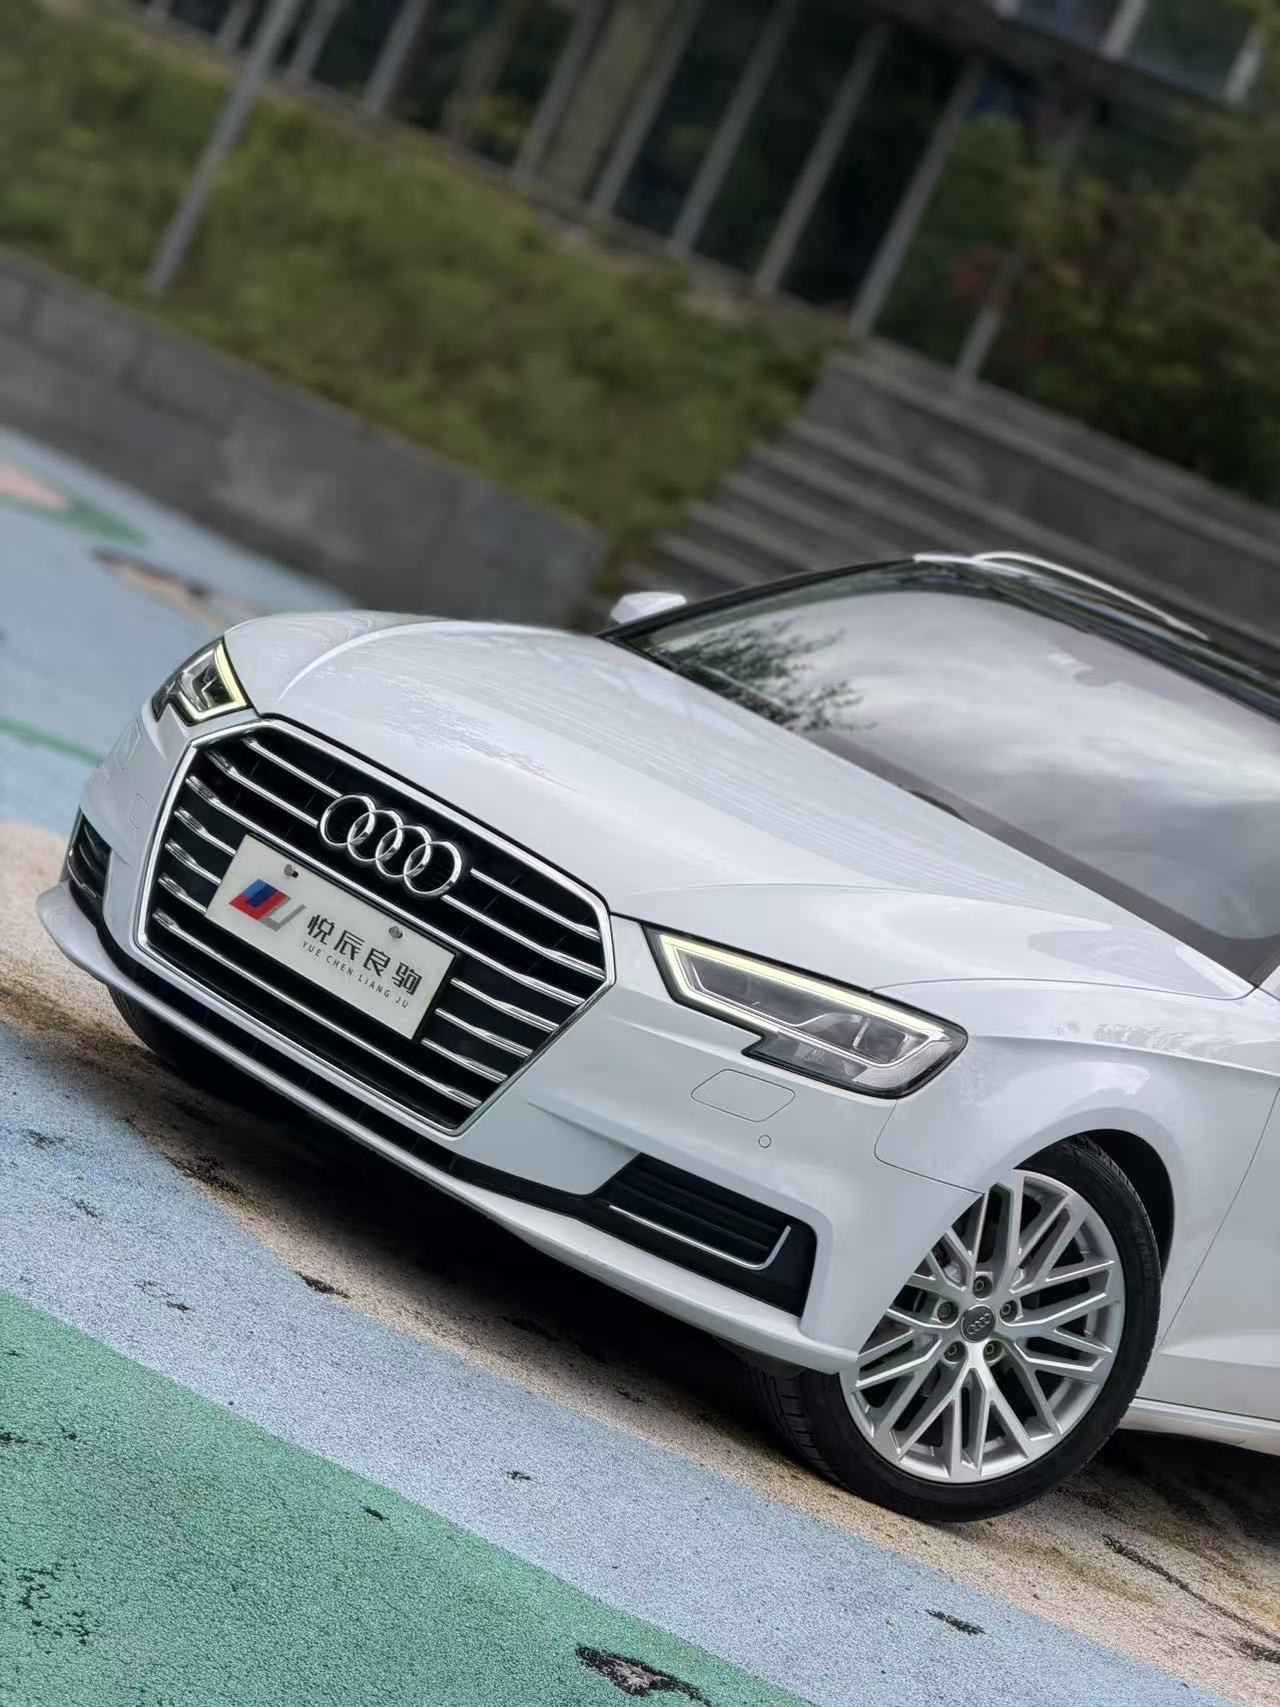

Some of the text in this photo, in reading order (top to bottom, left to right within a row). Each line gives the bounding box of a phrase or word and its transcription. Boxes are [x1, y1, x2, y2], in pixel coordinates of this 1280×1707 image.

[302, 940, 409, 1008] YUE CHEN LIANG JU
[307, 914, 423, 996] 悦辰良驹
